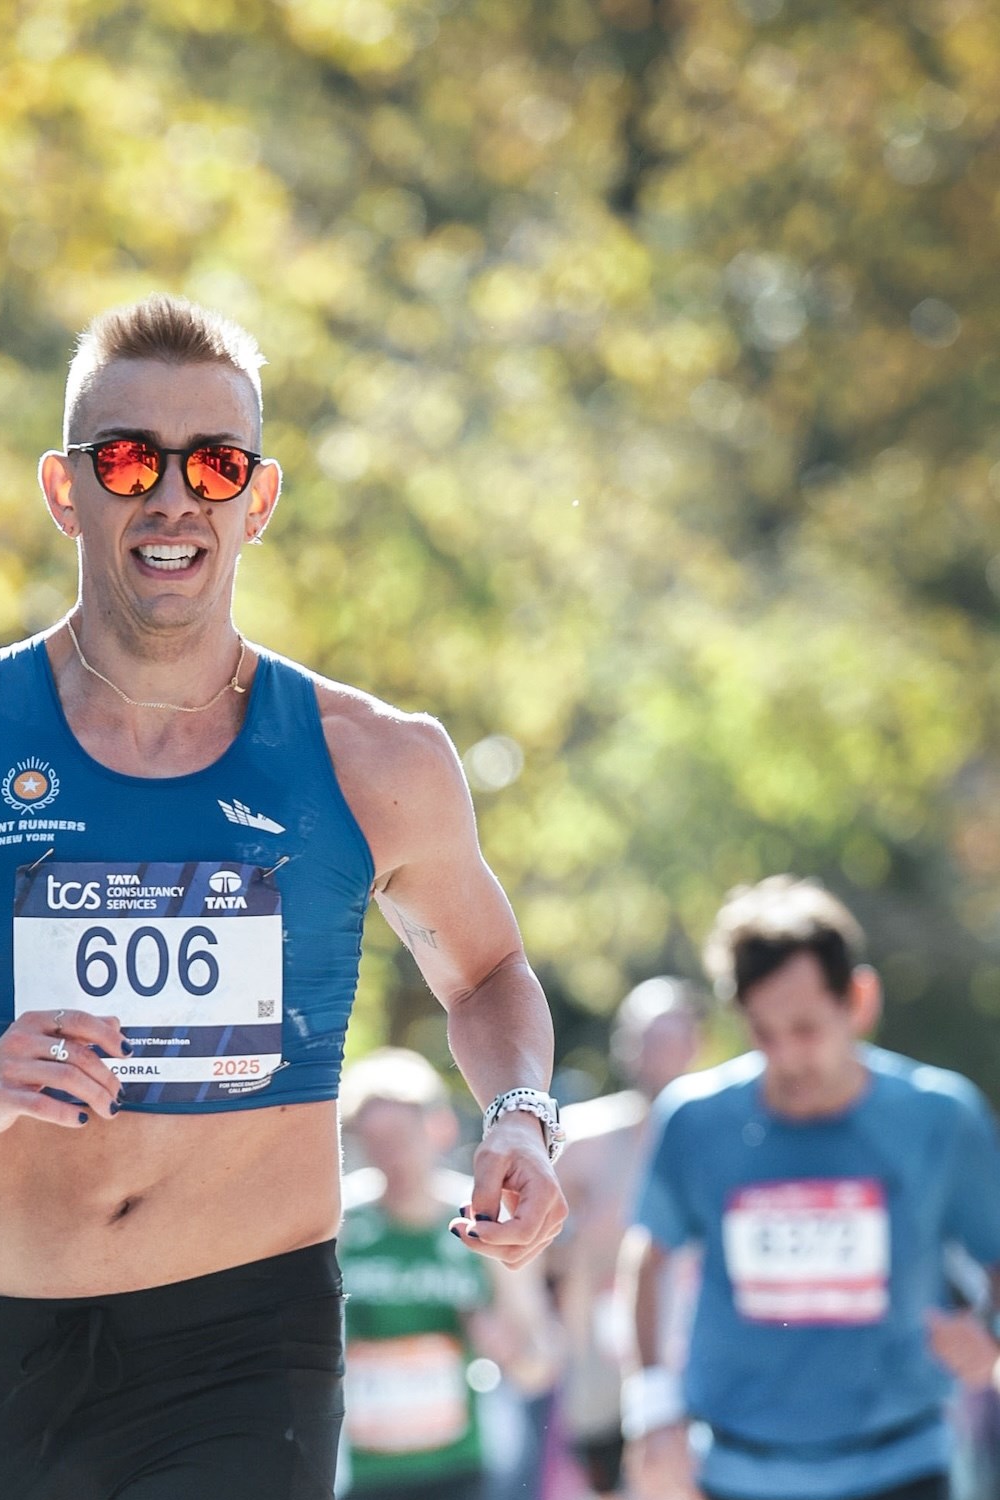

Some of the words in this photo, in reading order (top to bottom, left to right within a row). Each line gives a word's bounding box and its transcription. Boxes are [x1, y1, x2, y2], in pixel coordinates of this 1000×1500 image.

[18, 819, 86, 832] RUNNERS
[26, 833, 55, 842] YORK
[107, 875, 140, 885] TATA
[47, 875, 101, 910] tcs
[106, 886, 184, 898] CONSULTANCY
[106, 899, 157, 910] SERVICES
[204, 896, 248, 909] TATA
[76, 925, 219, 997] 606
[129, 1037, 190, 1046] SNYCMarathon
[111, 1065, 161, 1075] CORRAL
[213, 1060, 260, 1077] 2025
